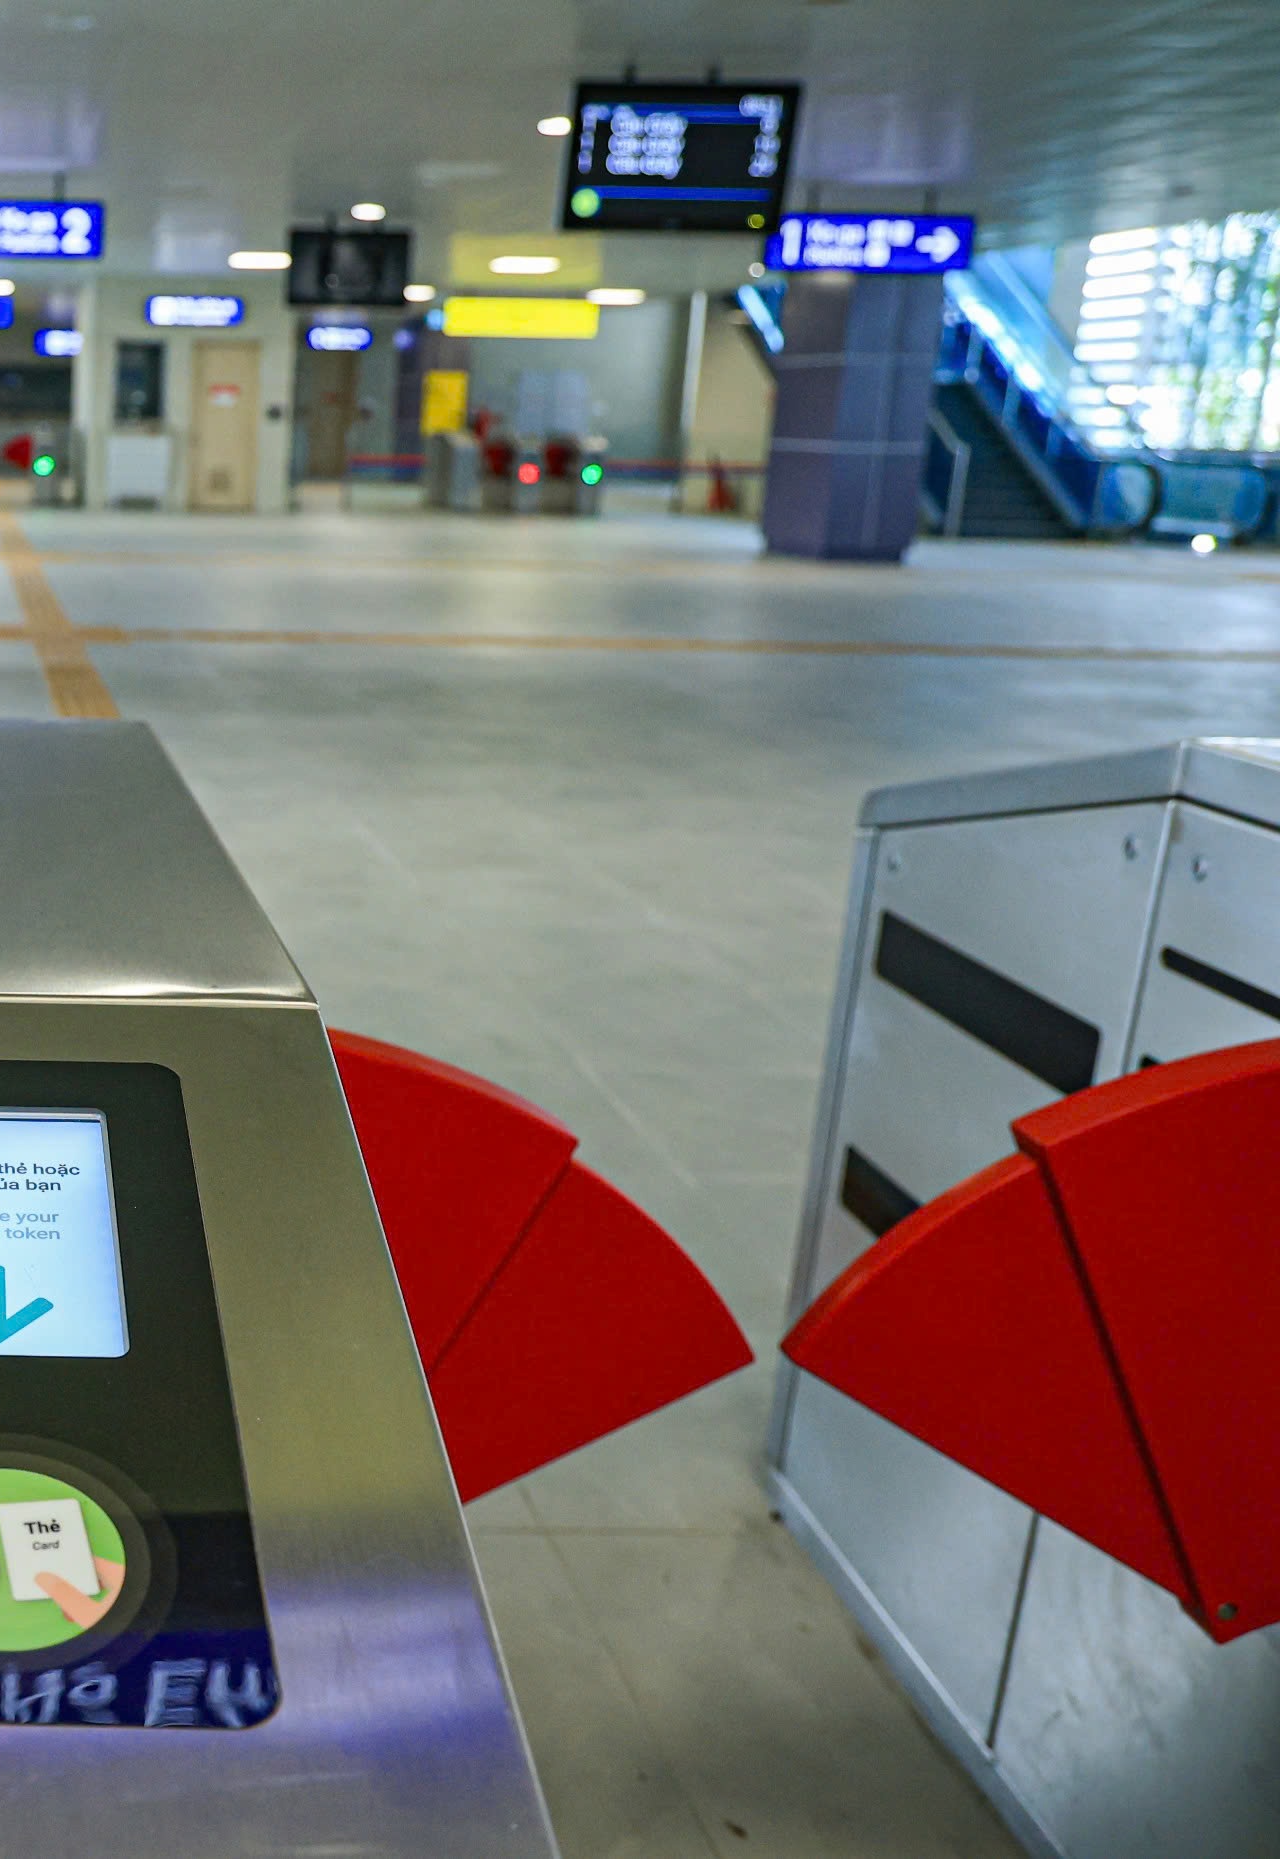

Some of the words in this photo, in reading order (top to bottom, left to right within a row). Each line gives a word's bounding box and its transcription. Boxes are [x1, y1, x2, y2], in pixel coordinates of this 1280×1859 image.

[60, 207, 93, 255] 2
[33, 1163, 81, 1178] hoặc
[25, 1179, 61, 1193] bạn
[15, 1212, 60, 1225] your
[4, 1227, 61, 1240] token
[24, 1518, 62, 1535] Thẻ
[32, 1540, 60, 1551] Card
